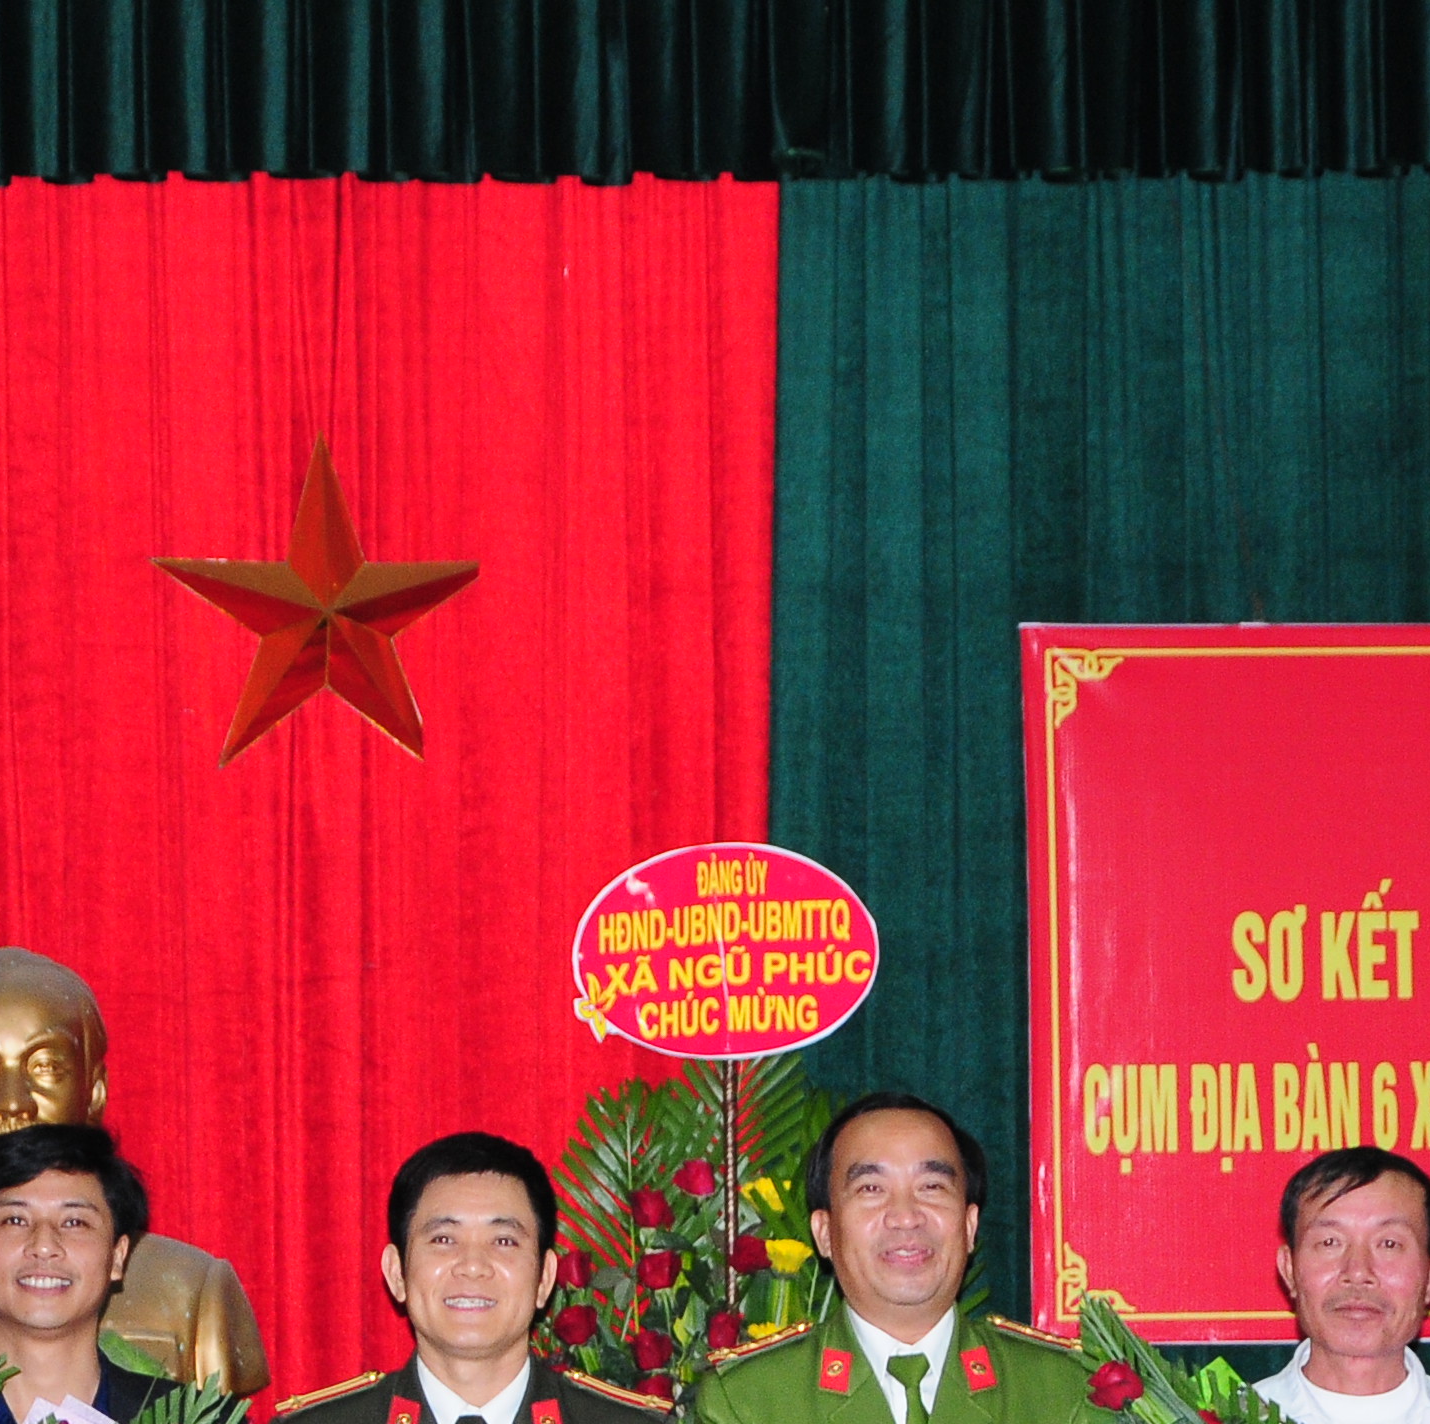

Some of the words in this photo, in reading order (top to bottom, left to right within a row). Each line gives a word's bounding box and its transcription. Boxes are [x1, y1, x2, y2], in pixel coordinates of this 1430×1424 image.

[697, 852, 742, 897] ĐẢNG
[745, 852, 768, 896] ỦY
[598, 898, 851, 955] HĐND-UBND-UBMTTQ
[1231, 903, 1308, 1002] SƠ
[1320, 878, 1420, 1001] KẾT
[605, 955, 658, 996] XÃ
[669, 946, 751, 991] NGŨ
[763, 944, 871, 984] PHÚC
[639, 991, 719, 1040] CHÚC
[727, 986, 818, 1033] MỪNG
[1083, 1062, 1179, 1174] CỤM
[1190, 1062, 1263, 1174] ĐỊA
[1273, 1042, 1361, 1152] BÀN
[1373, 1060, 1399, 1152] 6
